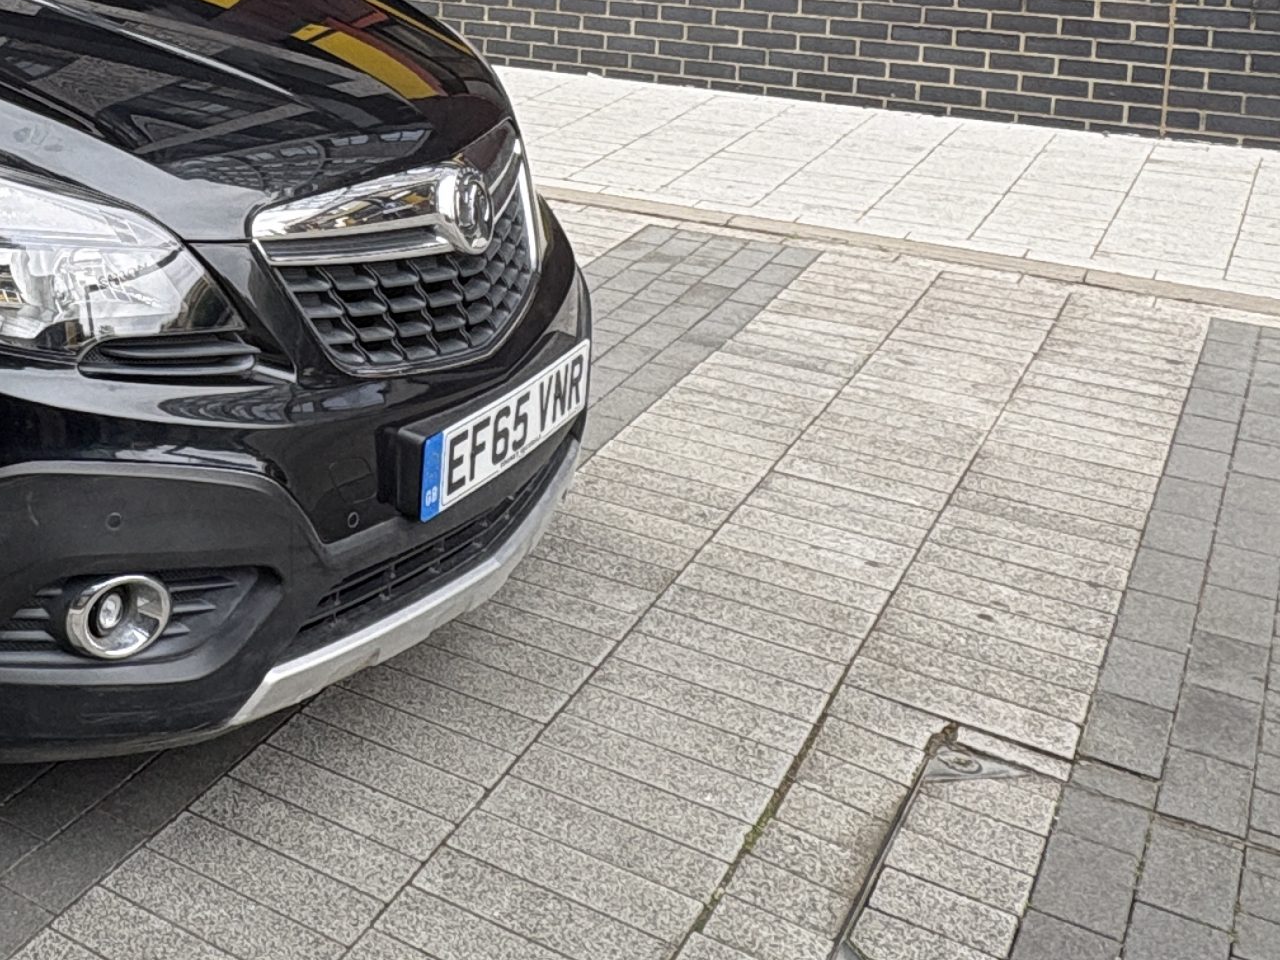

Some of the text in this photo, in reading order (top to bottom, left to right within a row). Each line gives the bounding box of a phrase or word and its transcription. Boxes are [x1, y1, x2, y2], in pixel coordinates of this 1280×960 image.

[448, 392, 530, 495] EF65
[539, 354, 584, 432] VNR
[425, 485, 438, 507] GB
